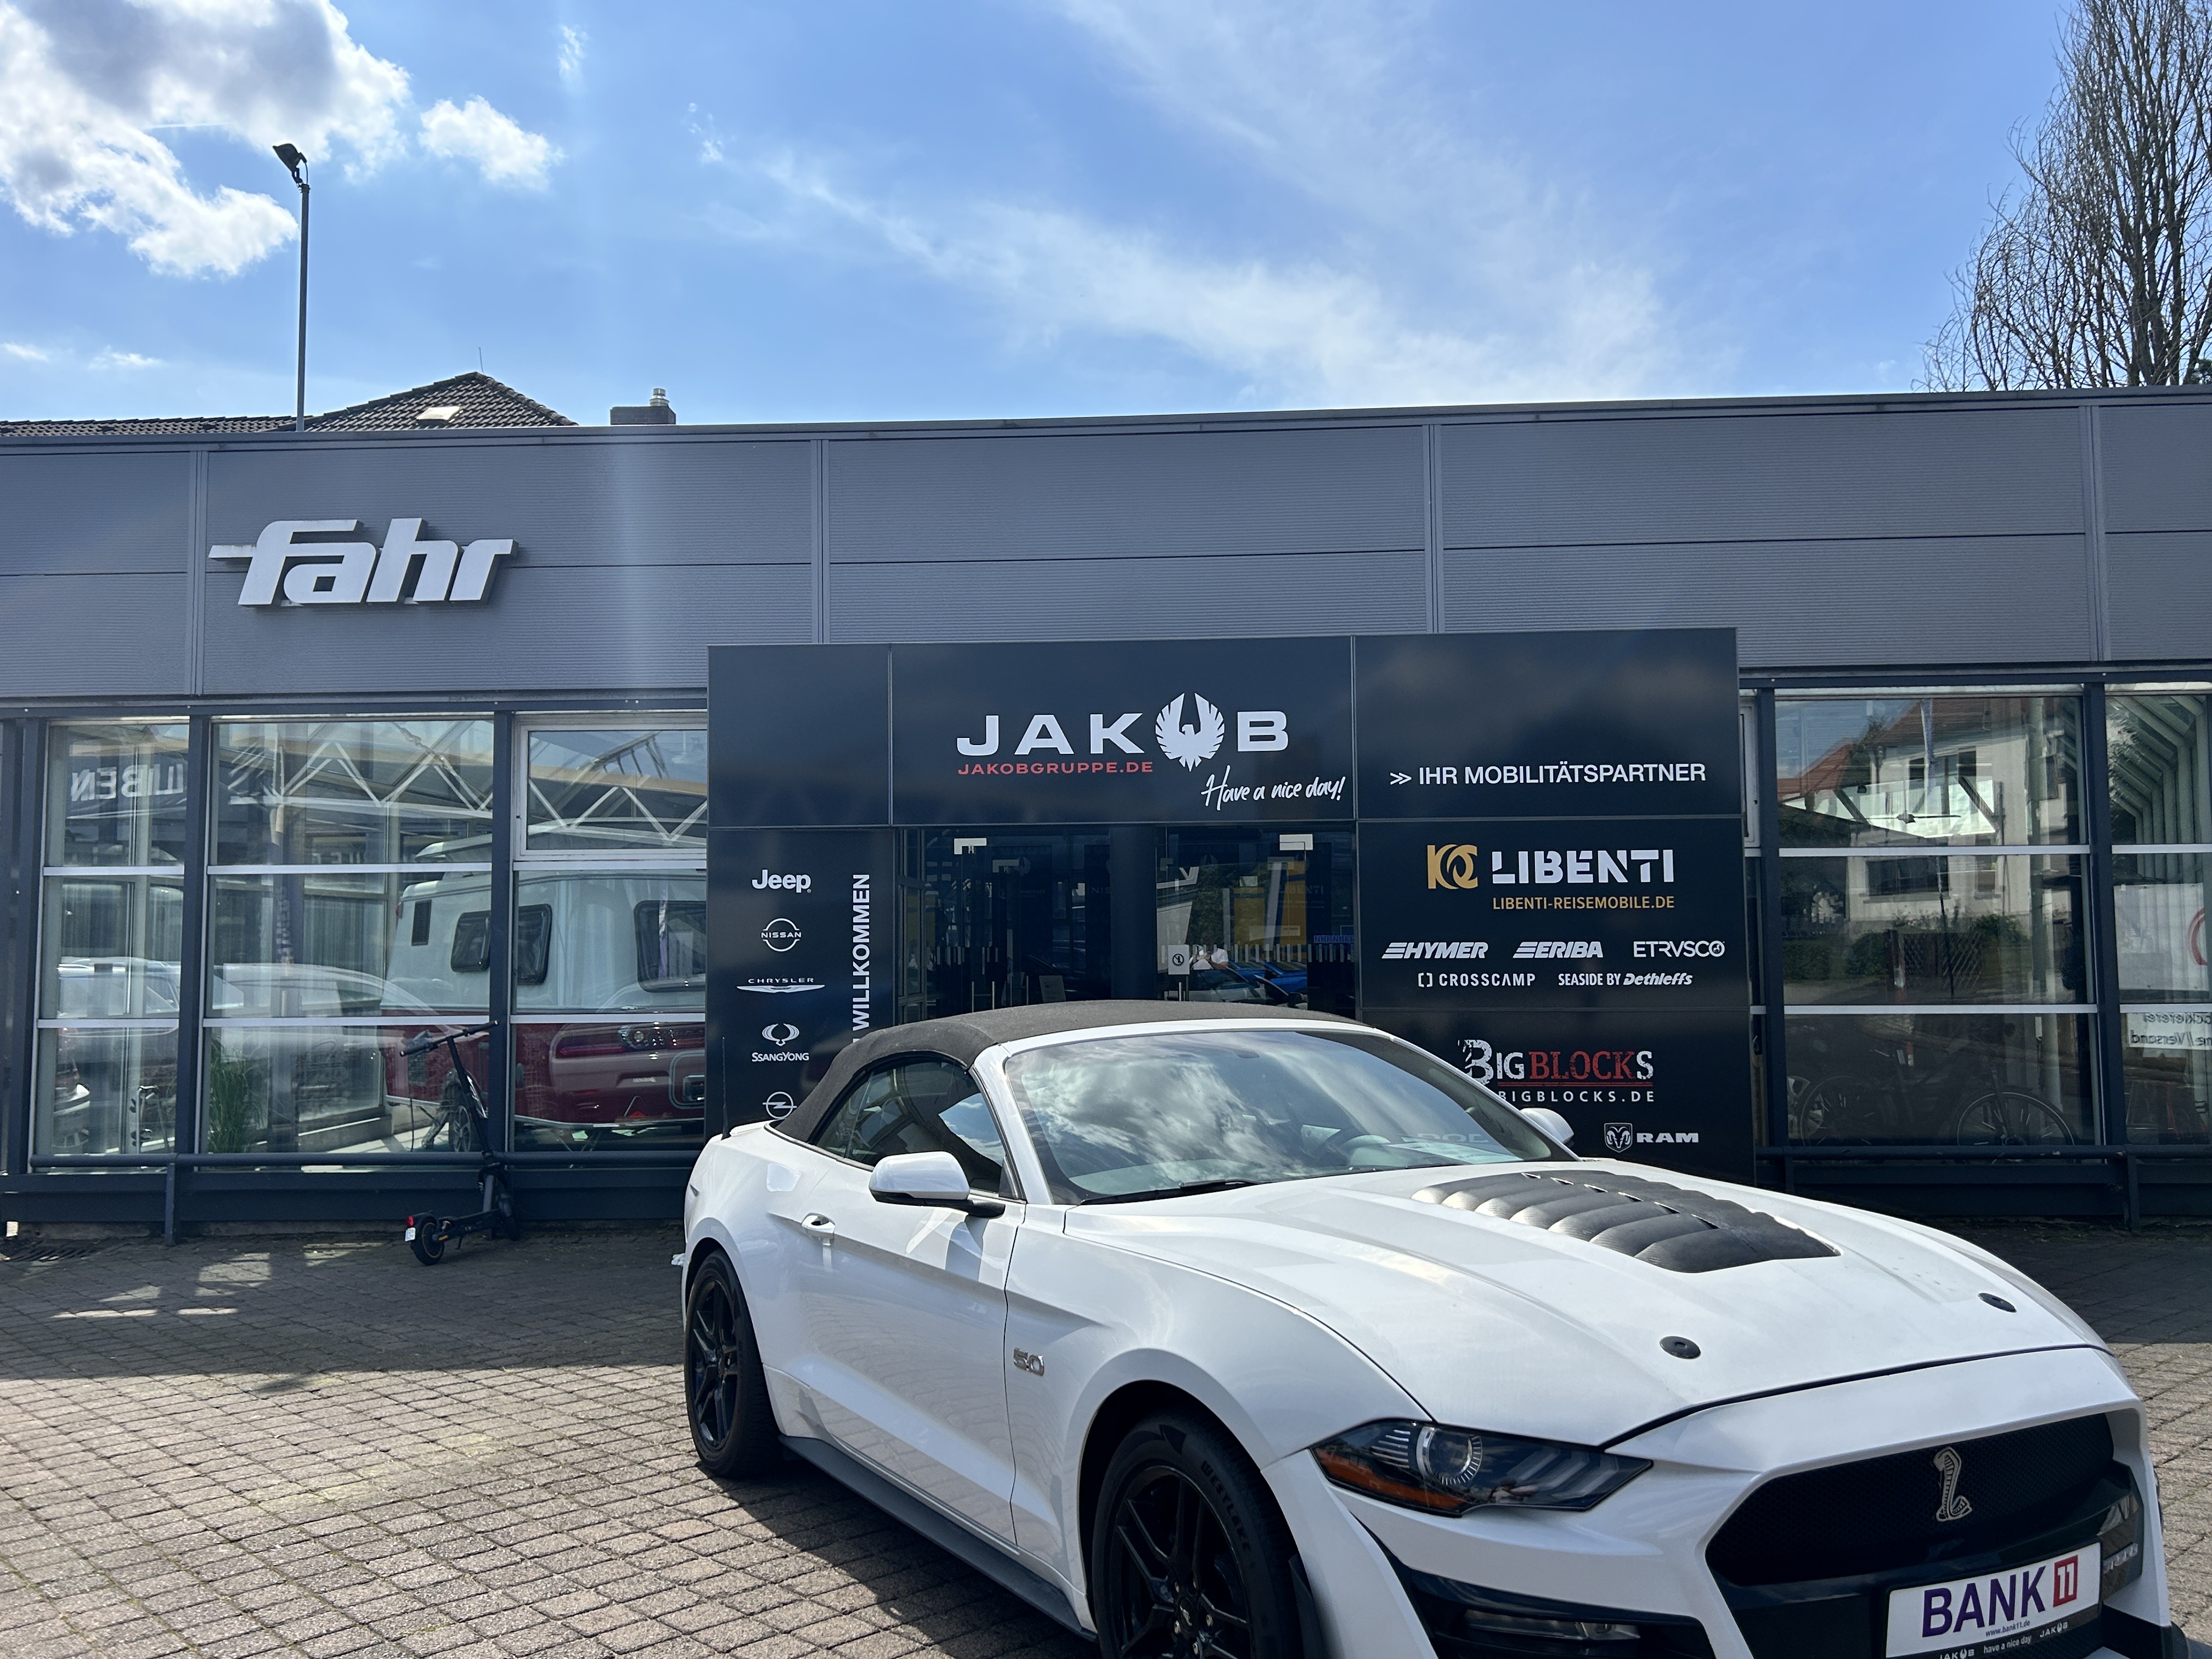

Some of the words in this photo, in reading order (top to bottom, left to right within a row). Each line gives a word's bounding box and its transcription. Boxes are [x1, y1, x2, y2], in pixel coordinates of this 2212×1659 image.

[208, 518, 518, 606] fahr
[958, 761, 1153, 775] JAKOBGRUPPE.DE
[1419, 767, 1458, 785] IHR
[1465, 761, 1706, 784] MOBILITÄTSPARTNER
[1201, 765, 1250, 810] Have
[1253, 786, 1265, 800] a
[1271, 781, 1302, 799] nice
[1305, 776, 1346, 801] day!
[1492, 849, 1674, 884] LIBENTI
[752, 870, 811, 893] Jeep
[1493, 896, 1675, 910] LIBENTI-REISEMOBILE.DE
[853, 874, 870, 1031] WILLKOMMEN
[1403, 942, 1488, 958] HYMER
[1535, 941, 1603, 958] ERIBA
[1438, 973, 1536, 986] CROSSCAMP
[1558, 973, 1603, 985] SEASIDE
[1606, 973, 1621, 985] BY
[1622, 973, 1693, 985] Dethleffs
[1498, 1091, 1654, 1102] BIGBLOCKS.DE
[1637, 1132, 1699, 1143] RAM
[1922, 1565, 2046, 1638] BANK
[1983, 1644, 2000, 1654] have
[2007, 1638, 2019, 1648] nice
[2021, 1635, 2032, 1645] day
